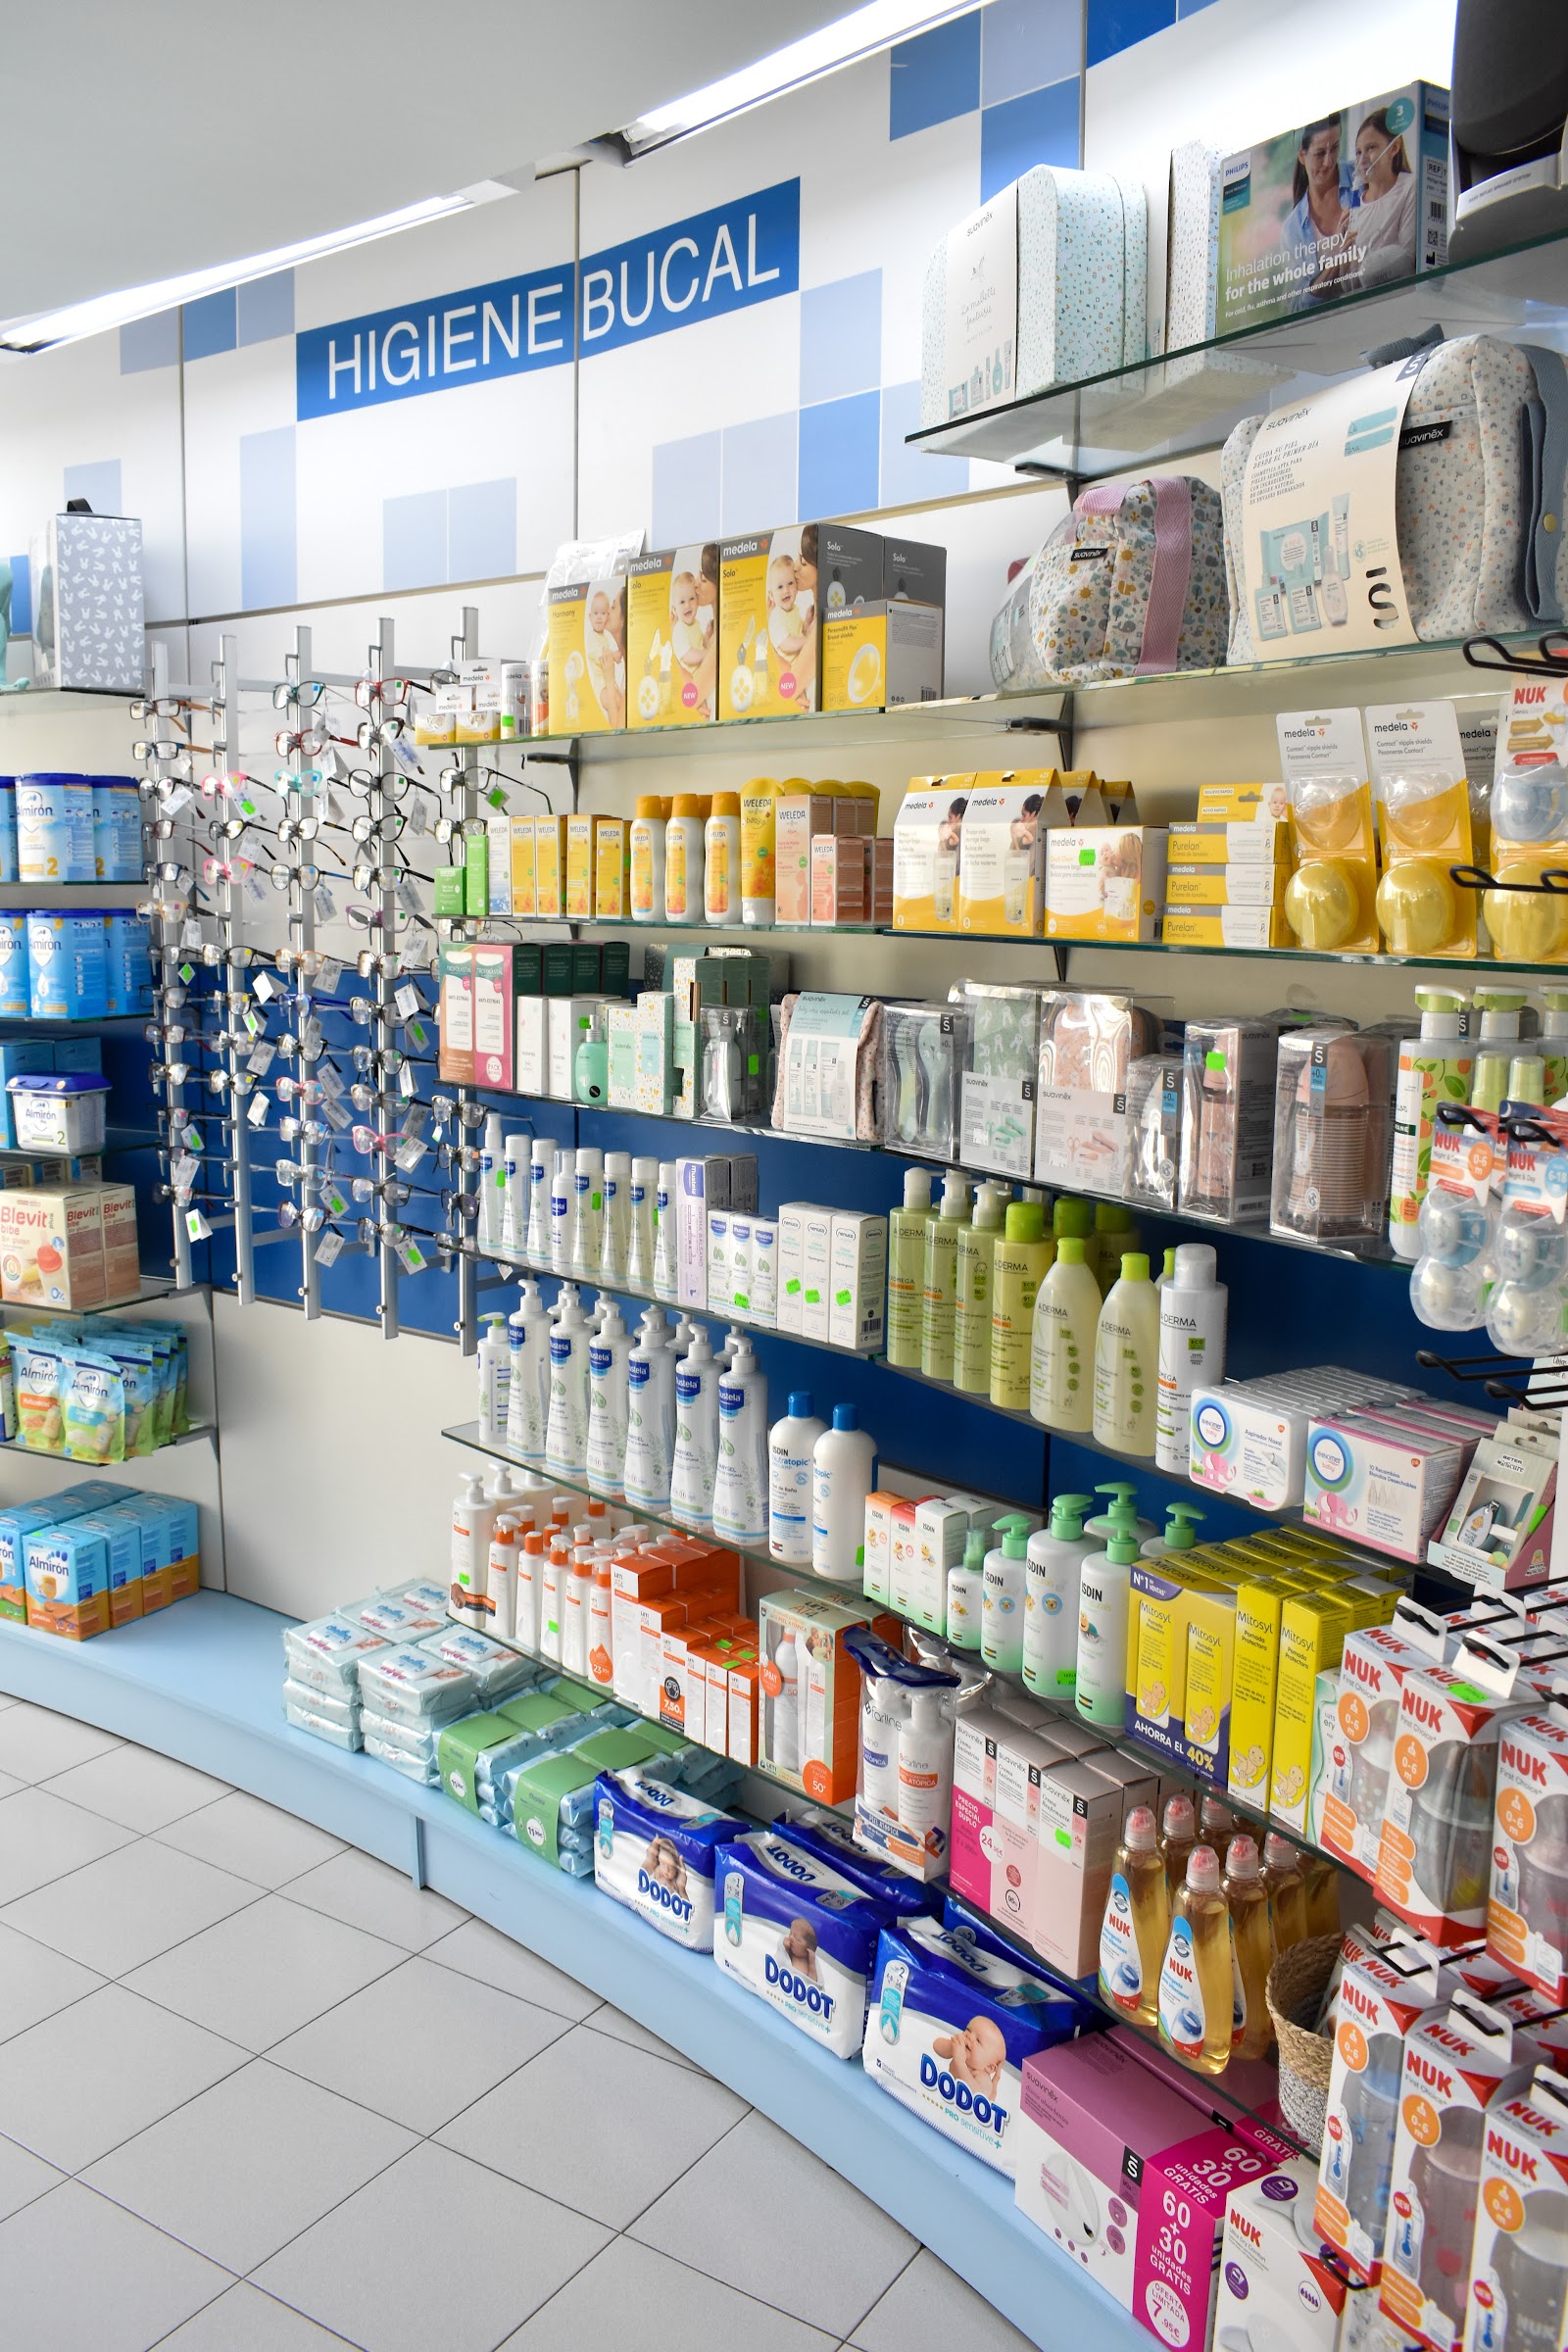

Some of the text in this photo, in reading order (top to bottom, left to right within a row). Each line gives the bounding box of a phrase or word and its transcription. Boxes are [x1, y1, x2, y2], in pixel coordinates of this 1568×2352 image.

[1396, 105, 1403, 116] 3
[1225, 162, 1249, 176] PHILIPS
[1428, 164, 1441, 173] REF
[1226, 231, 1348, 282] Inhalation therapy
[1225, 245, 1367, 302] for the whole family
[1235, 306, 1247, 317] cold,
[1256, 297, 1275, 309] asthma
[1277, 293, 1287, 303] and
[1288, 288, 1302, 299] other
[1303, 279, 1333, 294] respiratory
[328, 214, 780, 399] HIGIENE BUCAL
[1284, 440, 1298, 452] PIEL
[1253, 458, 1273, 469] DESDE
[1283, 446, 1306, 460] PRIMER
[723, 540, 758, 557] medela
[827, 541, 841, 552] Solo
[630, 558, 662, 573] medela
[893, 553, 906, 564] Solo
[723, 569, 735, 578] Solo
[552, 589, 578, 601] medela
[553, 610, 575, 618] Harmony
[827, 609, 853, 619] medela
[1513, 686, 1546, 705] NUK
[1284, 728, 1315, 739] medela
[1374, 721, 1408, 733] medela
[743, 798, 772, 808] WELEDA
[971, 798, 997, 807] medela
[779, 810, 807, 820] WELEDA
[1051, 837, 1077, 847] medela
[1173, 841, 1200, 851] Purelan
[47, 858, 59, 875] 2
[1171, 882, 1199, 892] Purelan
[1168, 922, 1195, 932] Purelan
[25, 1108, 57, 1119] Almirón
[57, 1131, 66, 1145] 2
[1435, 1132, 1462, 1152] NUK
[1473, 1154, 1487, 1165] 0-6
[1509, 1153, 1537, 1171] NUK
[1548, 1170, 1567, 1182] 6-18
[67, 1206, 95, 1221] Blevit
[104, 1200, 131, 1213] Blevit
[1, 1206, 47, 1228] Blevit
[784, 1219, 799, 1228] nenuco
[809, 1225, 825, 1234] nenuco
[72, 1378, 109, 1396] Almirón
[1245, 1429, 1282, 1446] Aspirador Nasal
[772, 1446, 789, 1456] ISDIN
[1503, 1454, 1523, 1464] BETER
[1321, 1461, 1335, 1472] baby
[1375, 1465, 1399, 1478] Recambios
[1369, 1471, 1416, 1490] Blandos Desechables
[872, 1509, 884, 1520] ISDIN
[898, 1522, 910, 1534] ISDIN
[923, 1522, 935, 1534] ISDIN
[28, 1553, 70, 1575] Almirón
[1027, 1558, 1046, 1578] ISDIN
[985, 1571, 1004, 1587] ISDIN
[952, 1584, 966, 1594] ISDIN
[1081, 1581, 1102, 1602] ISDIN
[789, 1605, 820, 1618] AT4
[806, 1601, 829, 1612] LETI
[1141, 1602, 1171, 1623] Mitosyl
[1147, 1623, 1164, 1635] Protectora
[1148, 1618, 1163, 1630] Pomada
[1238, 1610, 1273, 1634] Mitosyl
[1189, 1624, 1221, 1647] Mitosyl
[1242, 1636, 1267, 1650] Protectora
[1282, 1626, 1315, 1651] Mitosyl
[1364, 1629, 1410, 1654] NUK
[1286, 1652, 1309, 1669] Protectora
[1288, 1646, 1306, 1661] Pomada
[593, 1664, 603, 1675] 23
[763, 1668, 777, 1683] SPRAY
[1345, 1649, 1382, 1692] NUK
[1343, 1675, 1354, 1687] First
[1402, 1688, 1443, 1733] NUK
[871, 1706, 902, 1732] farline
[1346, 1716, 1359, 1730] 0-6
[1400, 1716, 1412, 1728] First
[1135, 1720, 1184, 1754] AHORRA EL
[766, 1762, 777, 1772] LETI
[1187, 1746, 1214, 1772] 40%
[1402, 1757, 1417, 1774] 0-6
[1501, 1740, 1548, 1787] NUK
[999, 1764, 1012, 1776] Crema
[1404, 1772, 1412, 1781] m
[1499, 1768, 1512, 1780] First
[908, 1777, 936, 1787] ATÓPICA
[635, 1781, 674, 1807] DODOT
[958, 1794, 978, 1812] PRECIO
[955, 1801, 981, 1823] ESPECIAL
[958, 1811, 976, 1828] DUPLO
[1505, 1809, 1525, 1829] 0-6
[1509, 1824, 1518, 1837] m
[981, 1834, 993, 1848] 24
[766, 1844, 816, 1883] DODOT
[1494, 1850, 1508, 1866] NEW
[638, 1868, 693, 1922] DODOT
[649, 1907, 660, 1918] PRO
[1109, 1913, 1130, 1937] NUK
[934, 1932, 989, 1973] DODOT
[899, 1967, 906, 1978] 2
[1169, 1957, 1193, 1983] NUK
[764, 1954, 833, 2020] DODOT
[785, 2001, 796, 2013] PRO
[1341, 2002, 1352, 2015] First
[1343, 1980, 1379, 2027] NUK
[1423, 2024, 1475, 2057] NUK
[1345, 2042, 1359, 2059] 0-6
[1407, 2050, 1452, 2098] NUK
[920, 2053, 1007, 2133] DODOT
[945, 2107, 958, 2122] PRO
[1505, 2101, 1560, 2137] NUK
[1328, 2120, 1342, 2135] NEW
[1410, 2114, 1429, 2133] 0-6
[1414, 2130, 1423, 2139] m
[1224, 2147, 1261, 2173] 60
[1488, 2130, 1538, 2181] NUK
[1175, 2163, 1218, 2199] unidades
[1192, 2159, 1232, 2187] 30
[1164, 2168, 1209, 2204] GRATIS
[1163, 2190, 1191, 2229] 60
[1394, 2196, 1410, 2211] NEW
[1493, 2199, 1512, 2219] 0-6
[1495, 2213, 1506, 2225] m
[1231, 2208, 1261, 2248] NUK
[1158, 2227, 1187, 2265] 30
[1152, 2244, 1192, 2282] unidades
[1150, 2254, 1191, 2296] GRATIS
[1154, 2282, 1184, 2312] OFERTA
[1474, 2284, 1492, 2302] NEW
[1152, 2289, 1185, 2323] LIMITADA
[1152, 2299, 1162, 2318] 7
